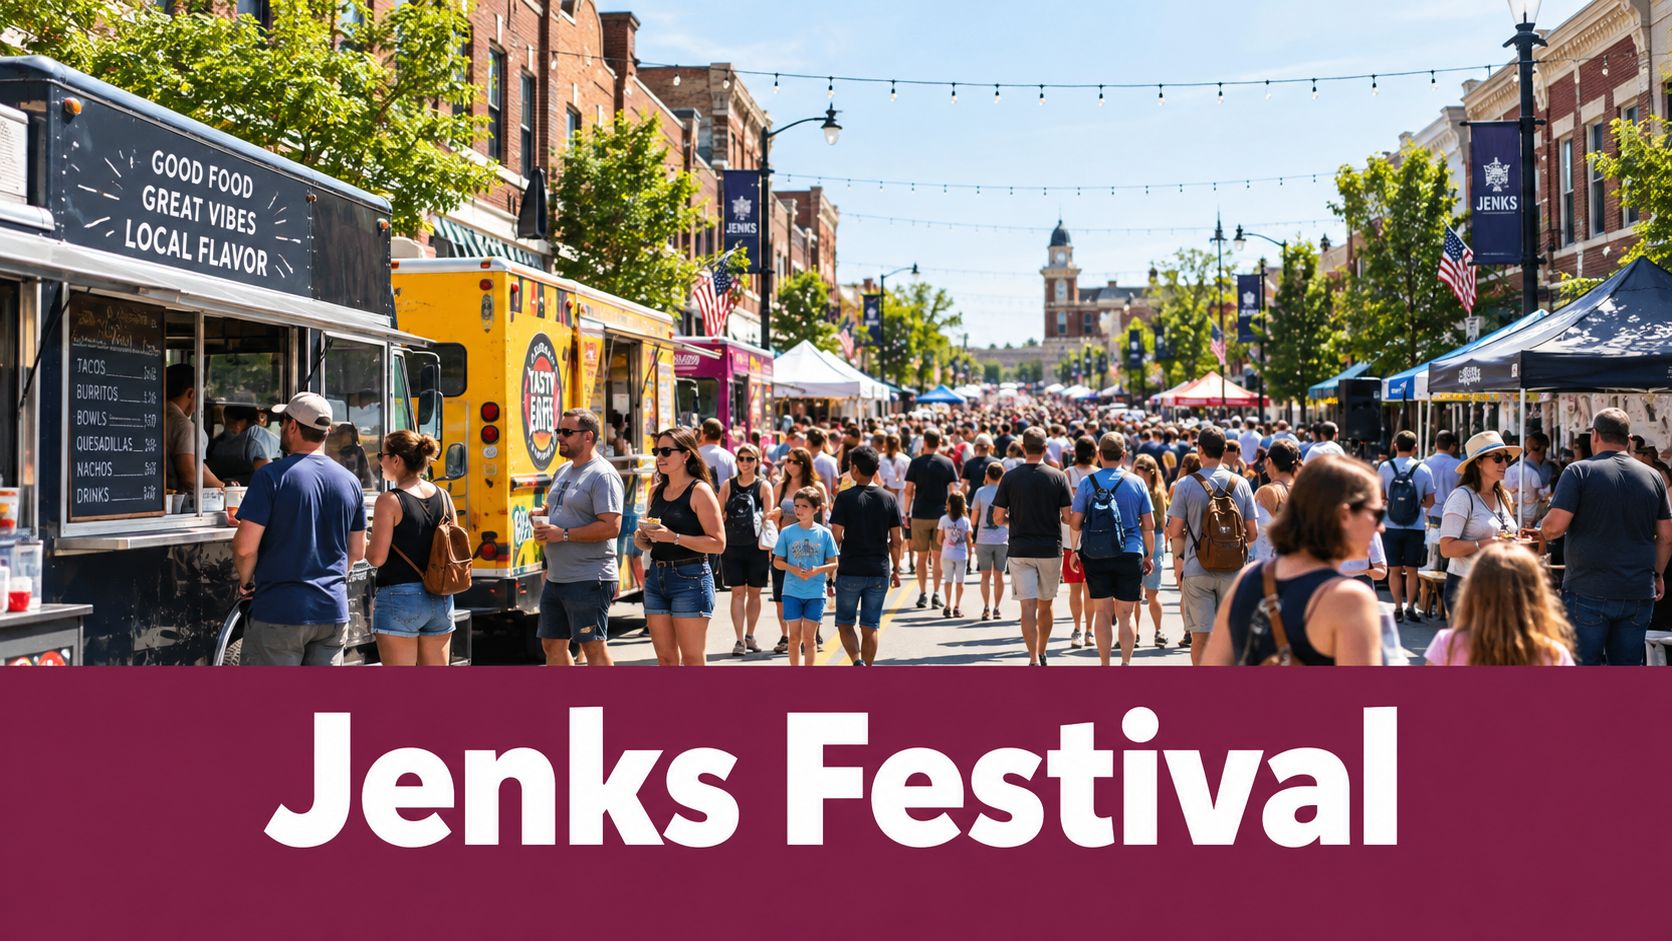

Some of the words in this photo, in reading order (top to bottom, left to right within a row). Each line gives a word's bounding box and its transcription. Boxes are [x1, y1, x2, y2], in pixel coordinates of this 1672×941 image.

[151, 149, 204, 185] GOOD
[208, 164, 254, 199] FOOD
[142, 184, 204, 223] GREAT
[208, 200, 257, 236] VIBES
[1476, 195, 1518, 211] JENKS
[726, 222, 758, 234] JENKS
[124, 218, 193, 261] LOCAL
[197, 235, 268, 277] FLAVOR
[76, 358, 106, 375] TACOS
[527, 367, 557, 396] TASTY
[76, 383, 118, 402] BURRITOS
[76, 409, 107, 426] BOWLS
[76, 435, 133, 452] QUESADILLAS
[76, 461, 113, 477] NACHOS
[76, 486, 110, 504] DRINKS
